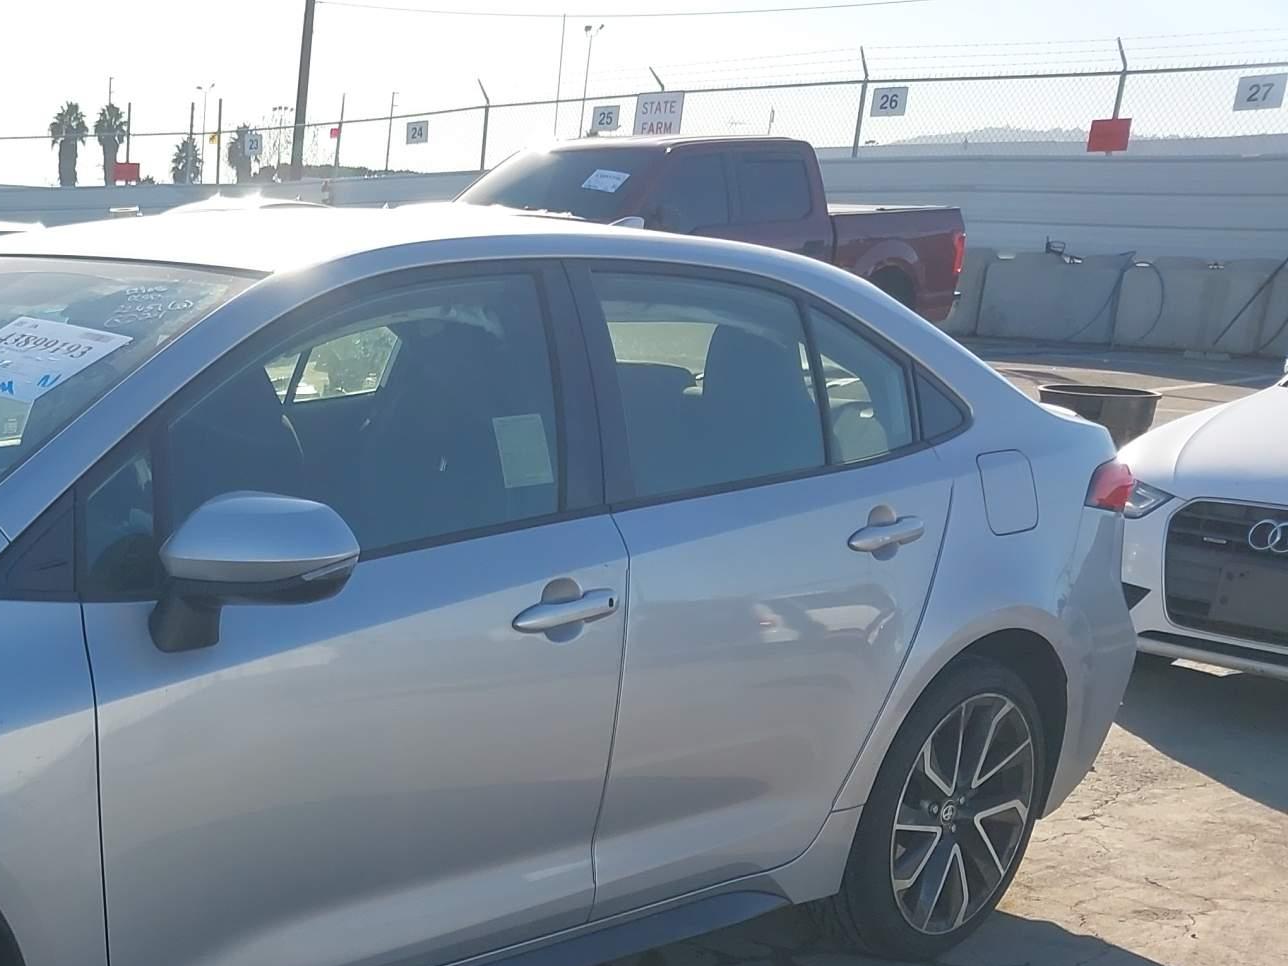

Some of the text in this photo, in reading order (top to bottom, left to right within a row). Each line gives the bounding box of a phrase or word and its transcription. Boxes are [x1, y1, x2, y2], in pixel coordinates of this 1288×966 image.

[1246, 83, 1276, 102] 27
[642, 101, 676, 115] STATE
[880, 94, 899, 110] 26
[598, 112, 613, 126] 25
[411, 127, 423, 139] 24
[641, 122, 673, 135] FARM
[248, 139, 259, 151] 23
